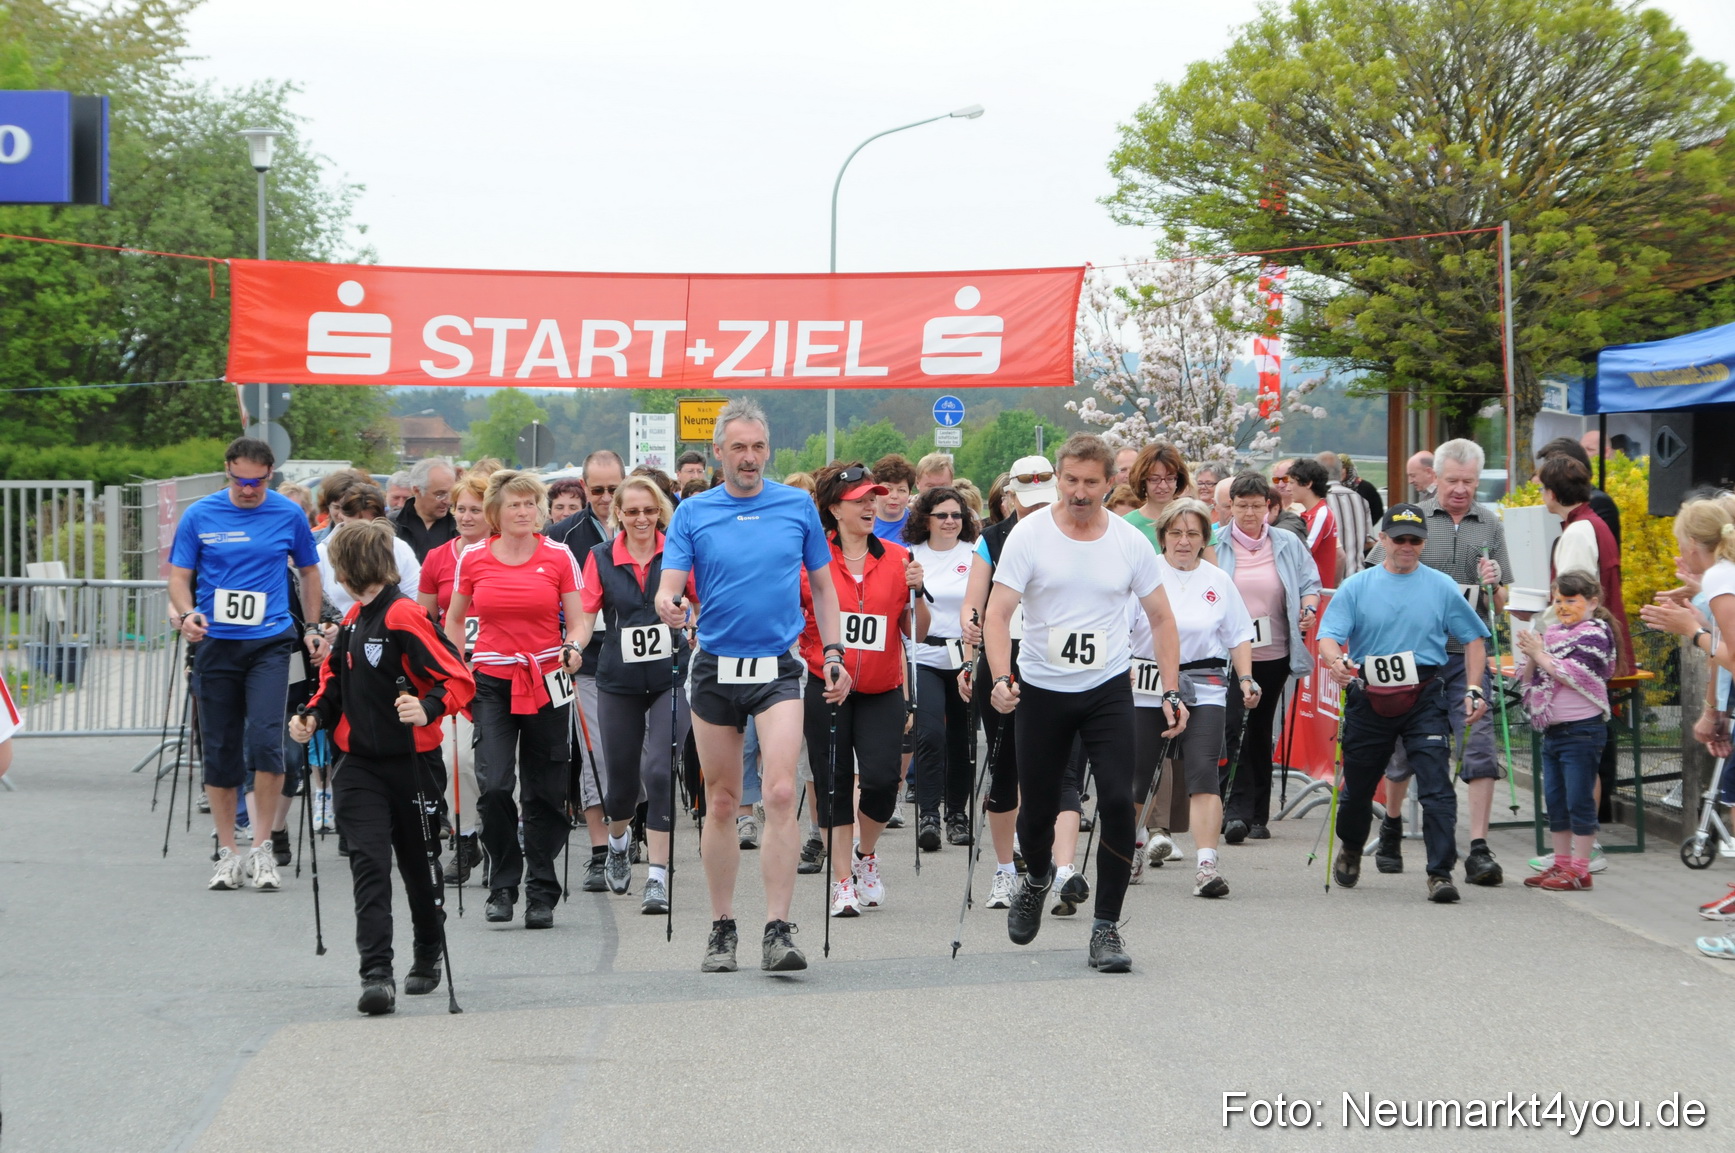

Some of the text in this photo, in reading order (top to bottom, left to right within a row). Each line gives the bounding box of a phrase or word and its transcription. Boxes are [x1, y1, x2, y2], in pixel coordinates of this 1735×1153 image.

[225, 592, 256, 620] 50
[632, 627, 662, 657] 92
[845, 614, 878, 645] 90
[1061, 632, 1096, 665] 45
[1138, 663, 1160, 691] 117
[1374, 655, 1406, 683] 89
